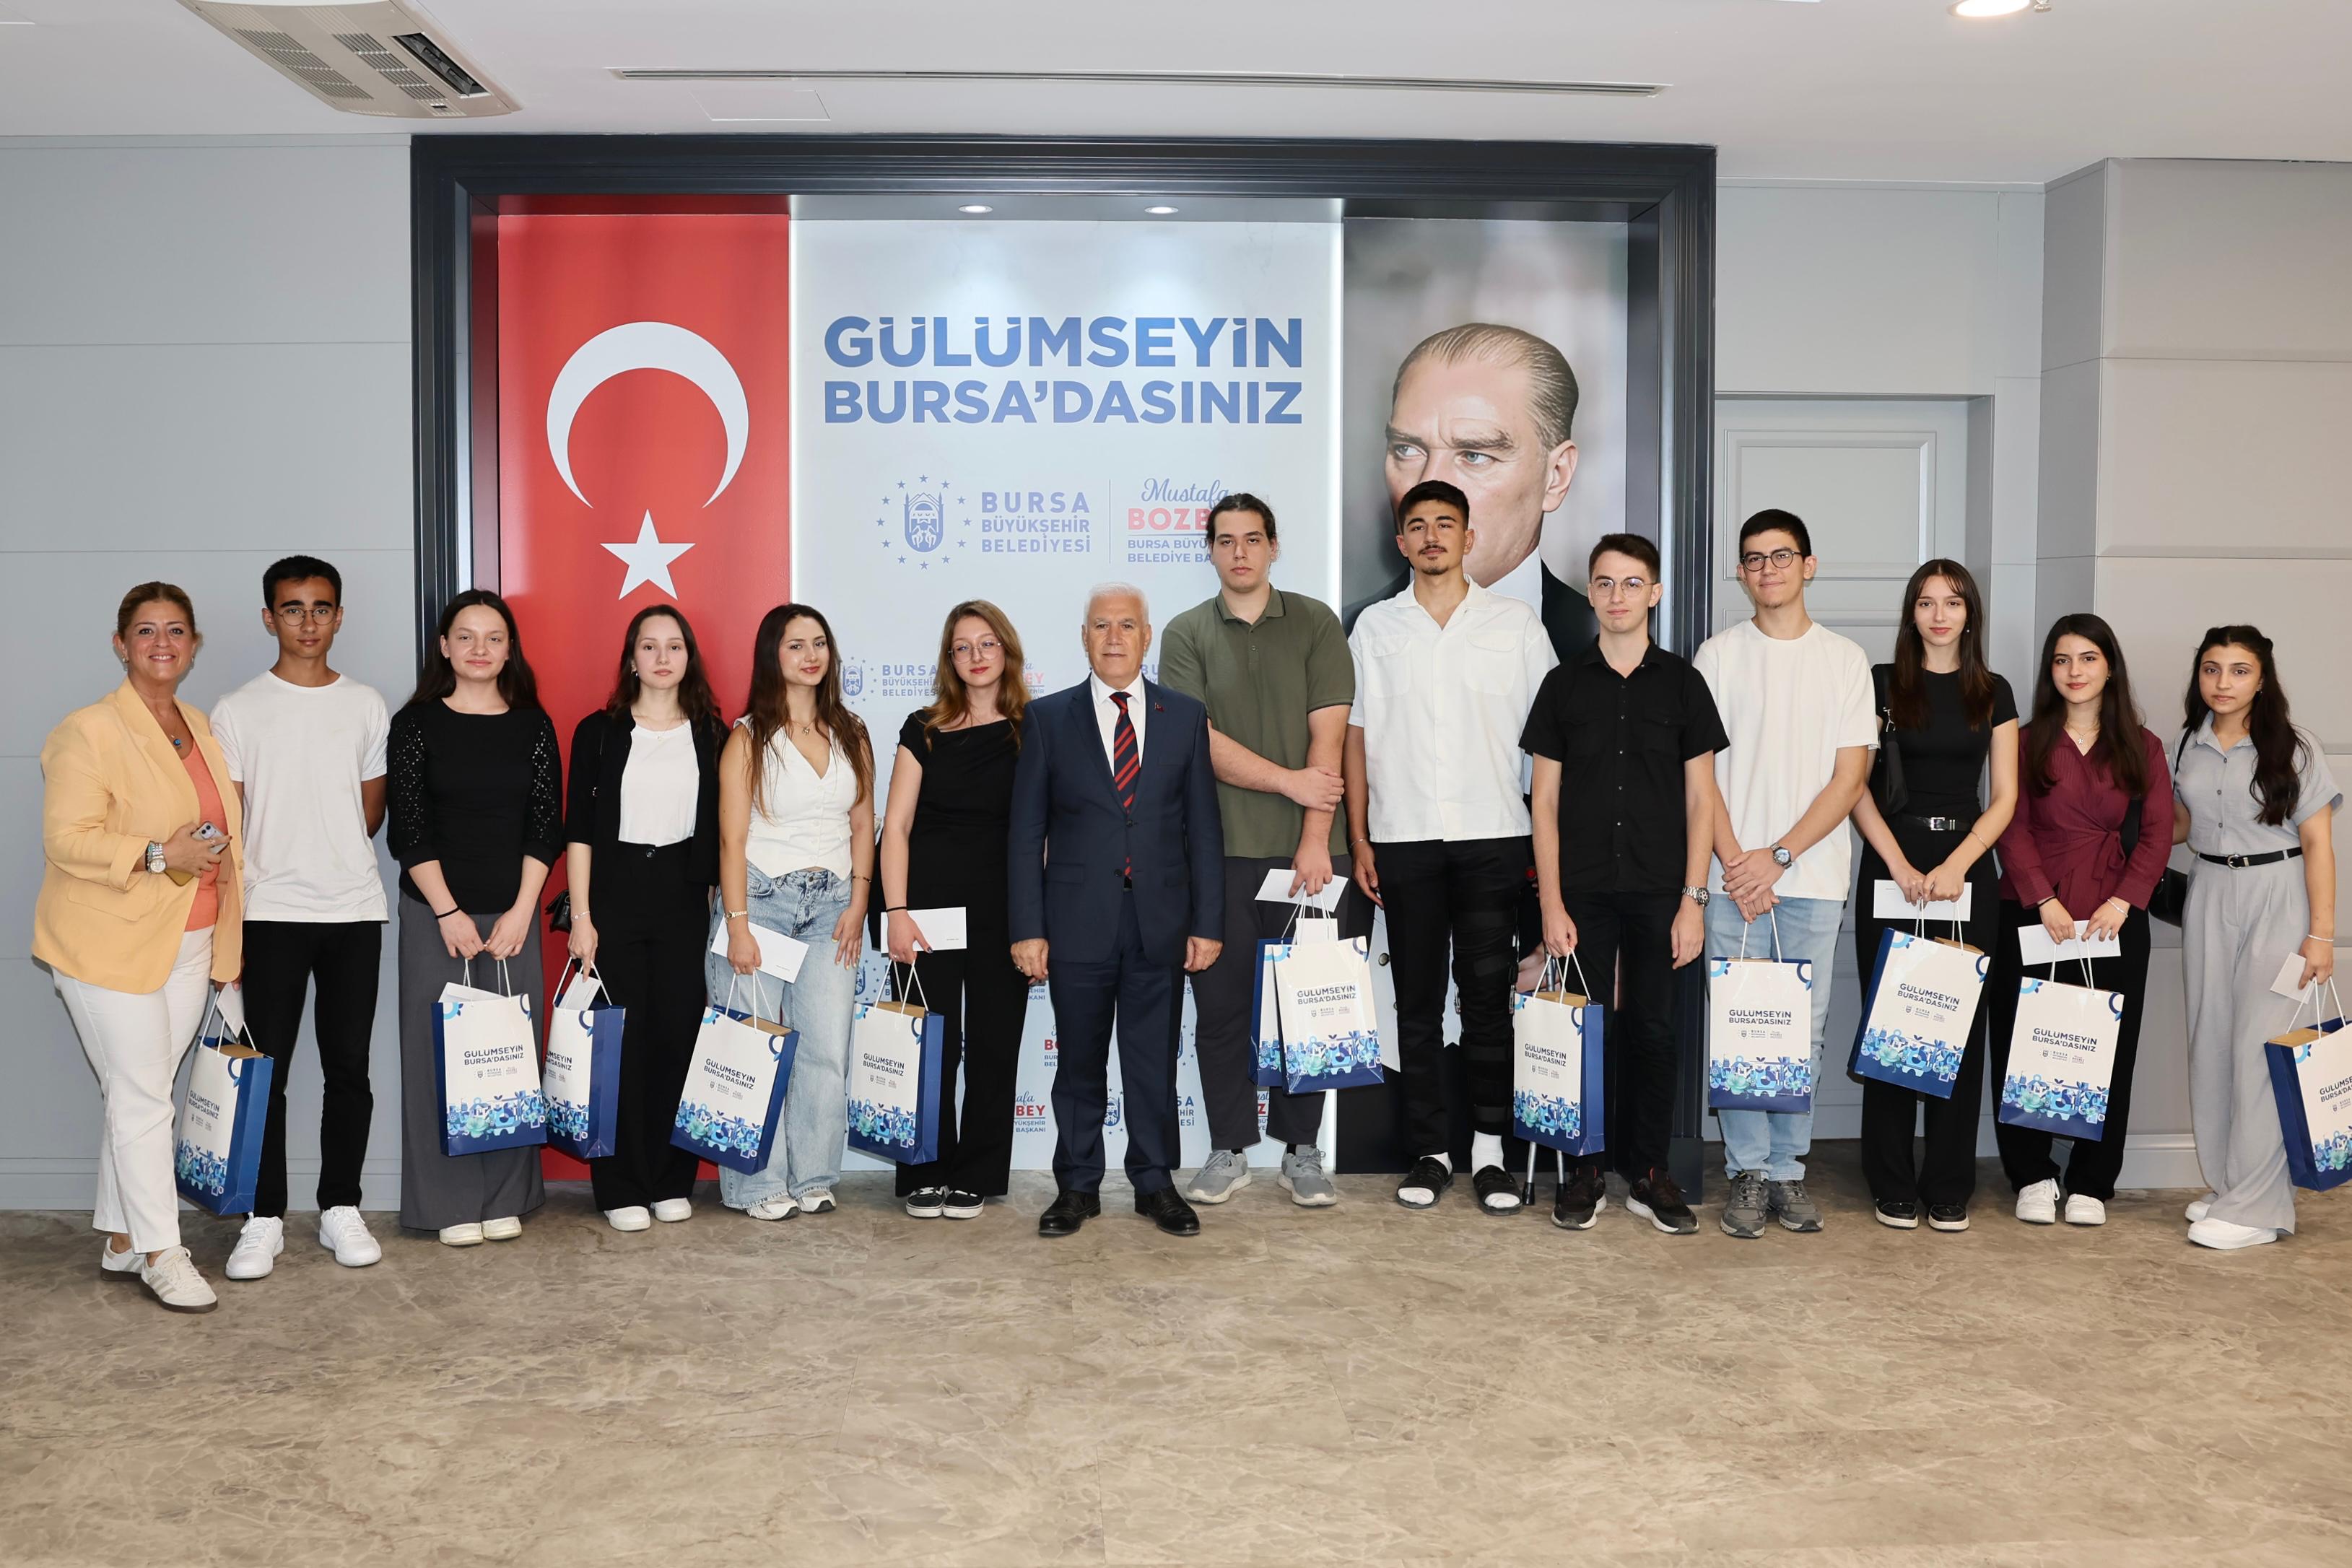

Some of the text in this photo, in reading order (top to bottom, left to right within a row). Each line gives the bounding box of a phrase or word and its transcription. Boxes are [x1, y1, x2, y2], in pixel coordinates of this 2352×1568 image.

[982, 492, 1090, 513] BURSA
[982, 515, 1090, 536] BÜYÜKŞEHİR
[1128, 508, 1211, 531] BOZB
[982, 535, 1091, 553] BELEDİYESİ
[1128, 539, 1170, 549] BURSA
[1128, 551, 1190, 562] BELEDİYE
[882, 665, 937, 676] BURSA
[882, 686, 937, 697] BELEDİYES
